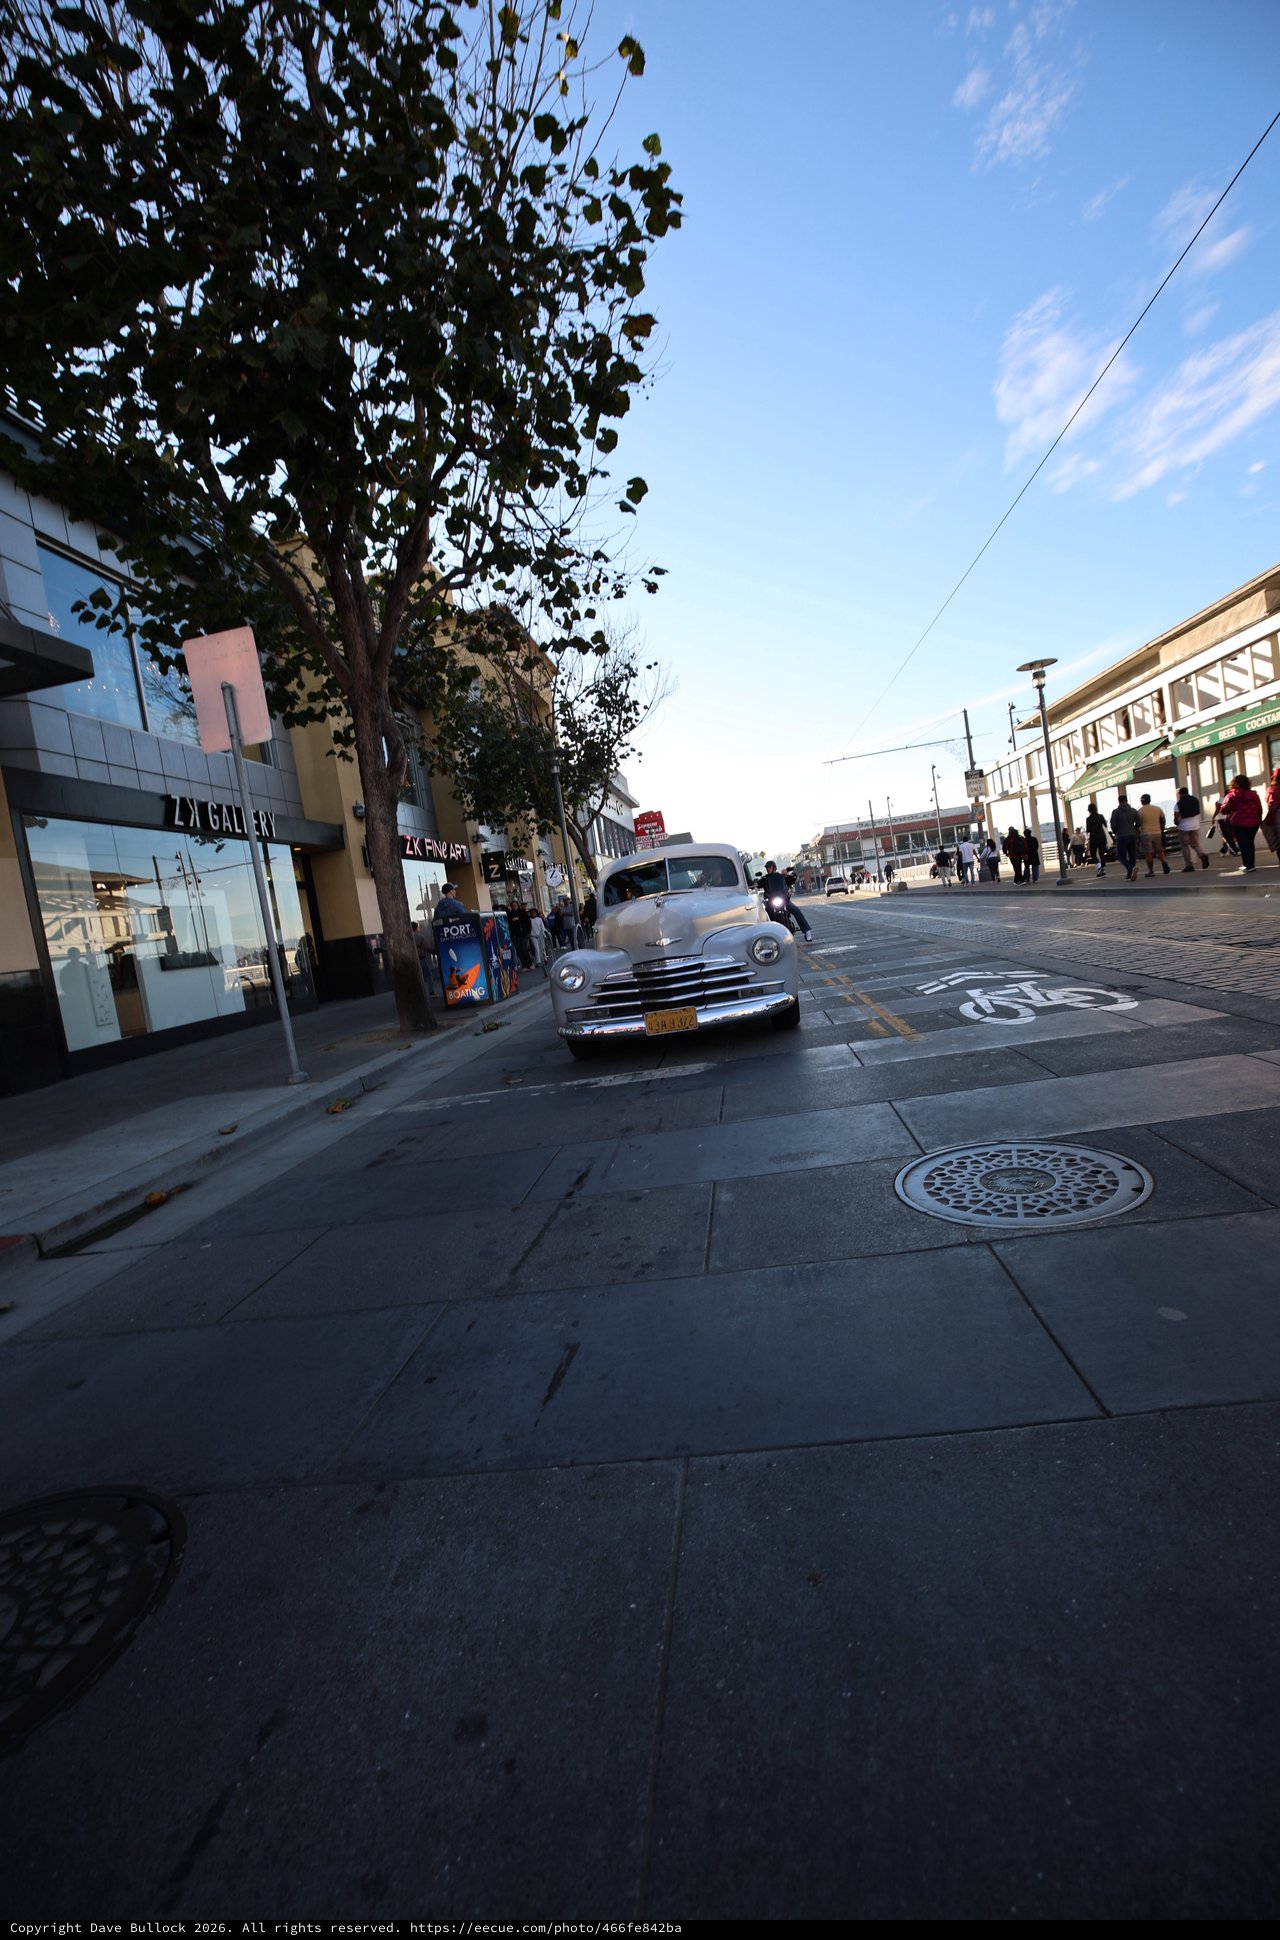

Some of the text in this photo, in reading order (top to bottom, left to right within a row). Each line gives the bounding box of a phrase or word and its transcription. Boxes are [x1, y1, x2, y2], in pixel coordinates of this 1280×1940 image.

[1178, 742, 1193, 753] FINE
[1193, 736, 1211, 749] WINE
[1218, 727, 1237, 740] BEER
[1107, 773, 1128, 786] SEAFOOD
[403, 834, 422, 857] ZK
[450, 843, 467, 861] ART
[489, 865, 501, 878] Z
[443, 924, 471, 937] PORT
[448, 987, 485, 999] BOATING
